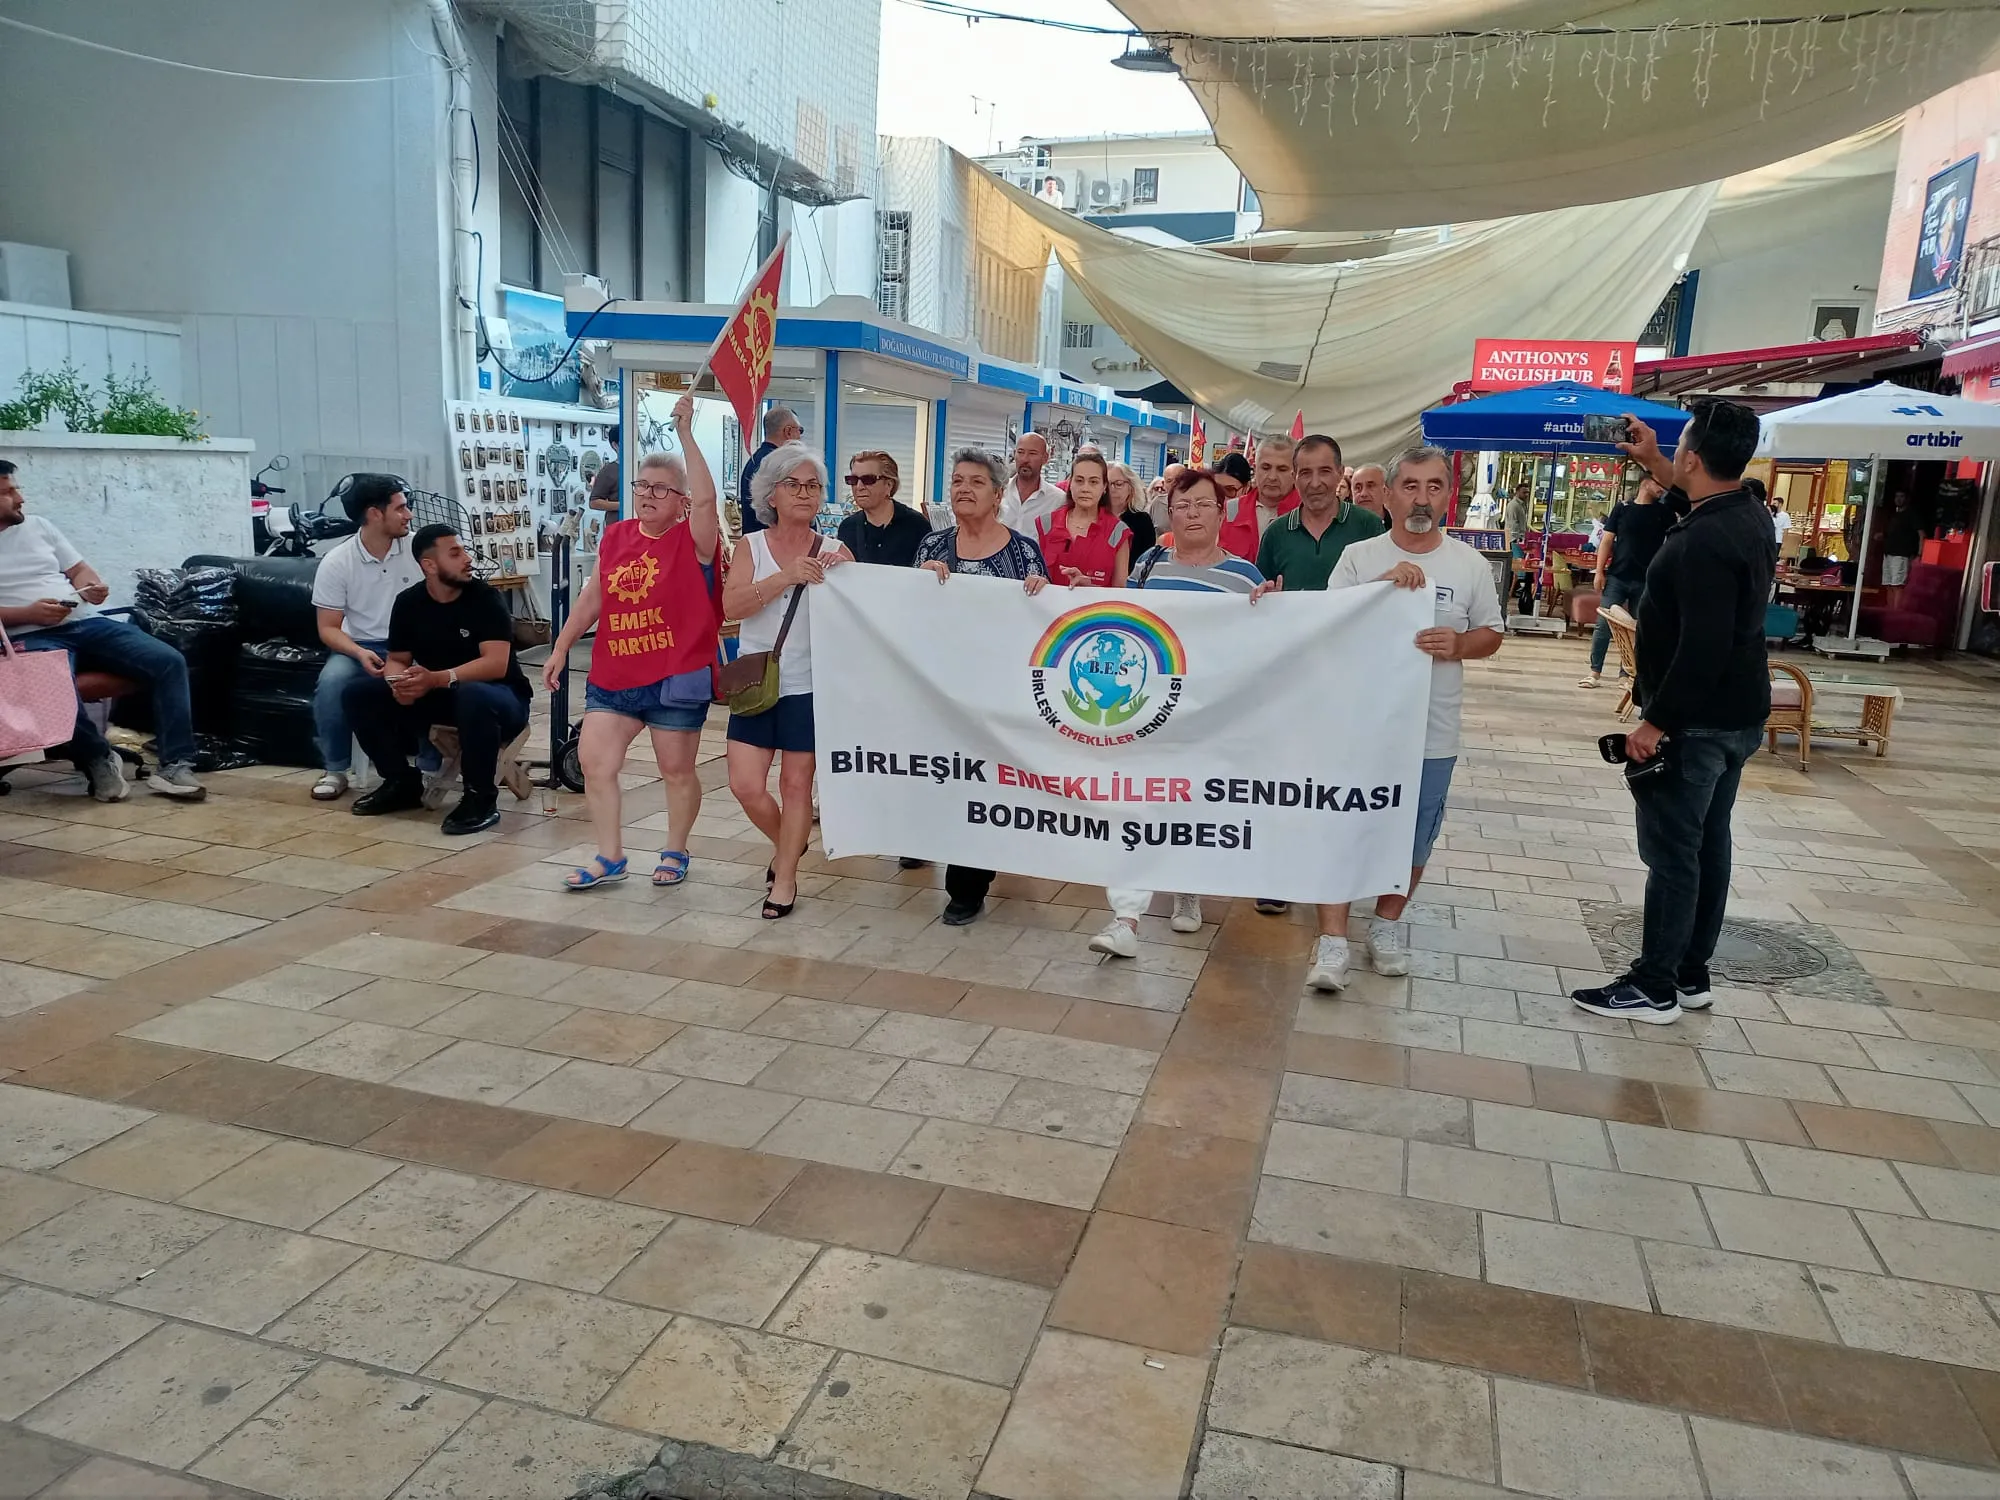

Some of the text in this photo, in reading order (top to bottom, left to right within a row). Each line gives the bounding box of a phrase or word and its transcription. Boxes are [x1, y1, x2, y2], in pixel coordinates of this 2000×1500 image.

[728, 327, 748, 368] EMEK
[1488, 350, 1589, 366] ANTHONY'S
[1480, 367, 1557, 382] ENGLISH
[1558, 369, 1593, 383] PUB
[608, 606, 664, 632] EMEK
[607, 626, 675, 656] PARTİSİ
[1031, 669, 1182, 747] BİRLEŞİK EMEKLİLER SENDİKASI
[831, 745, 1402, 812] BİRLEŞİK EMEKLİLER SENDİKASI
[967, 801, 1251, 851] BODRUM ŞUBESİ
